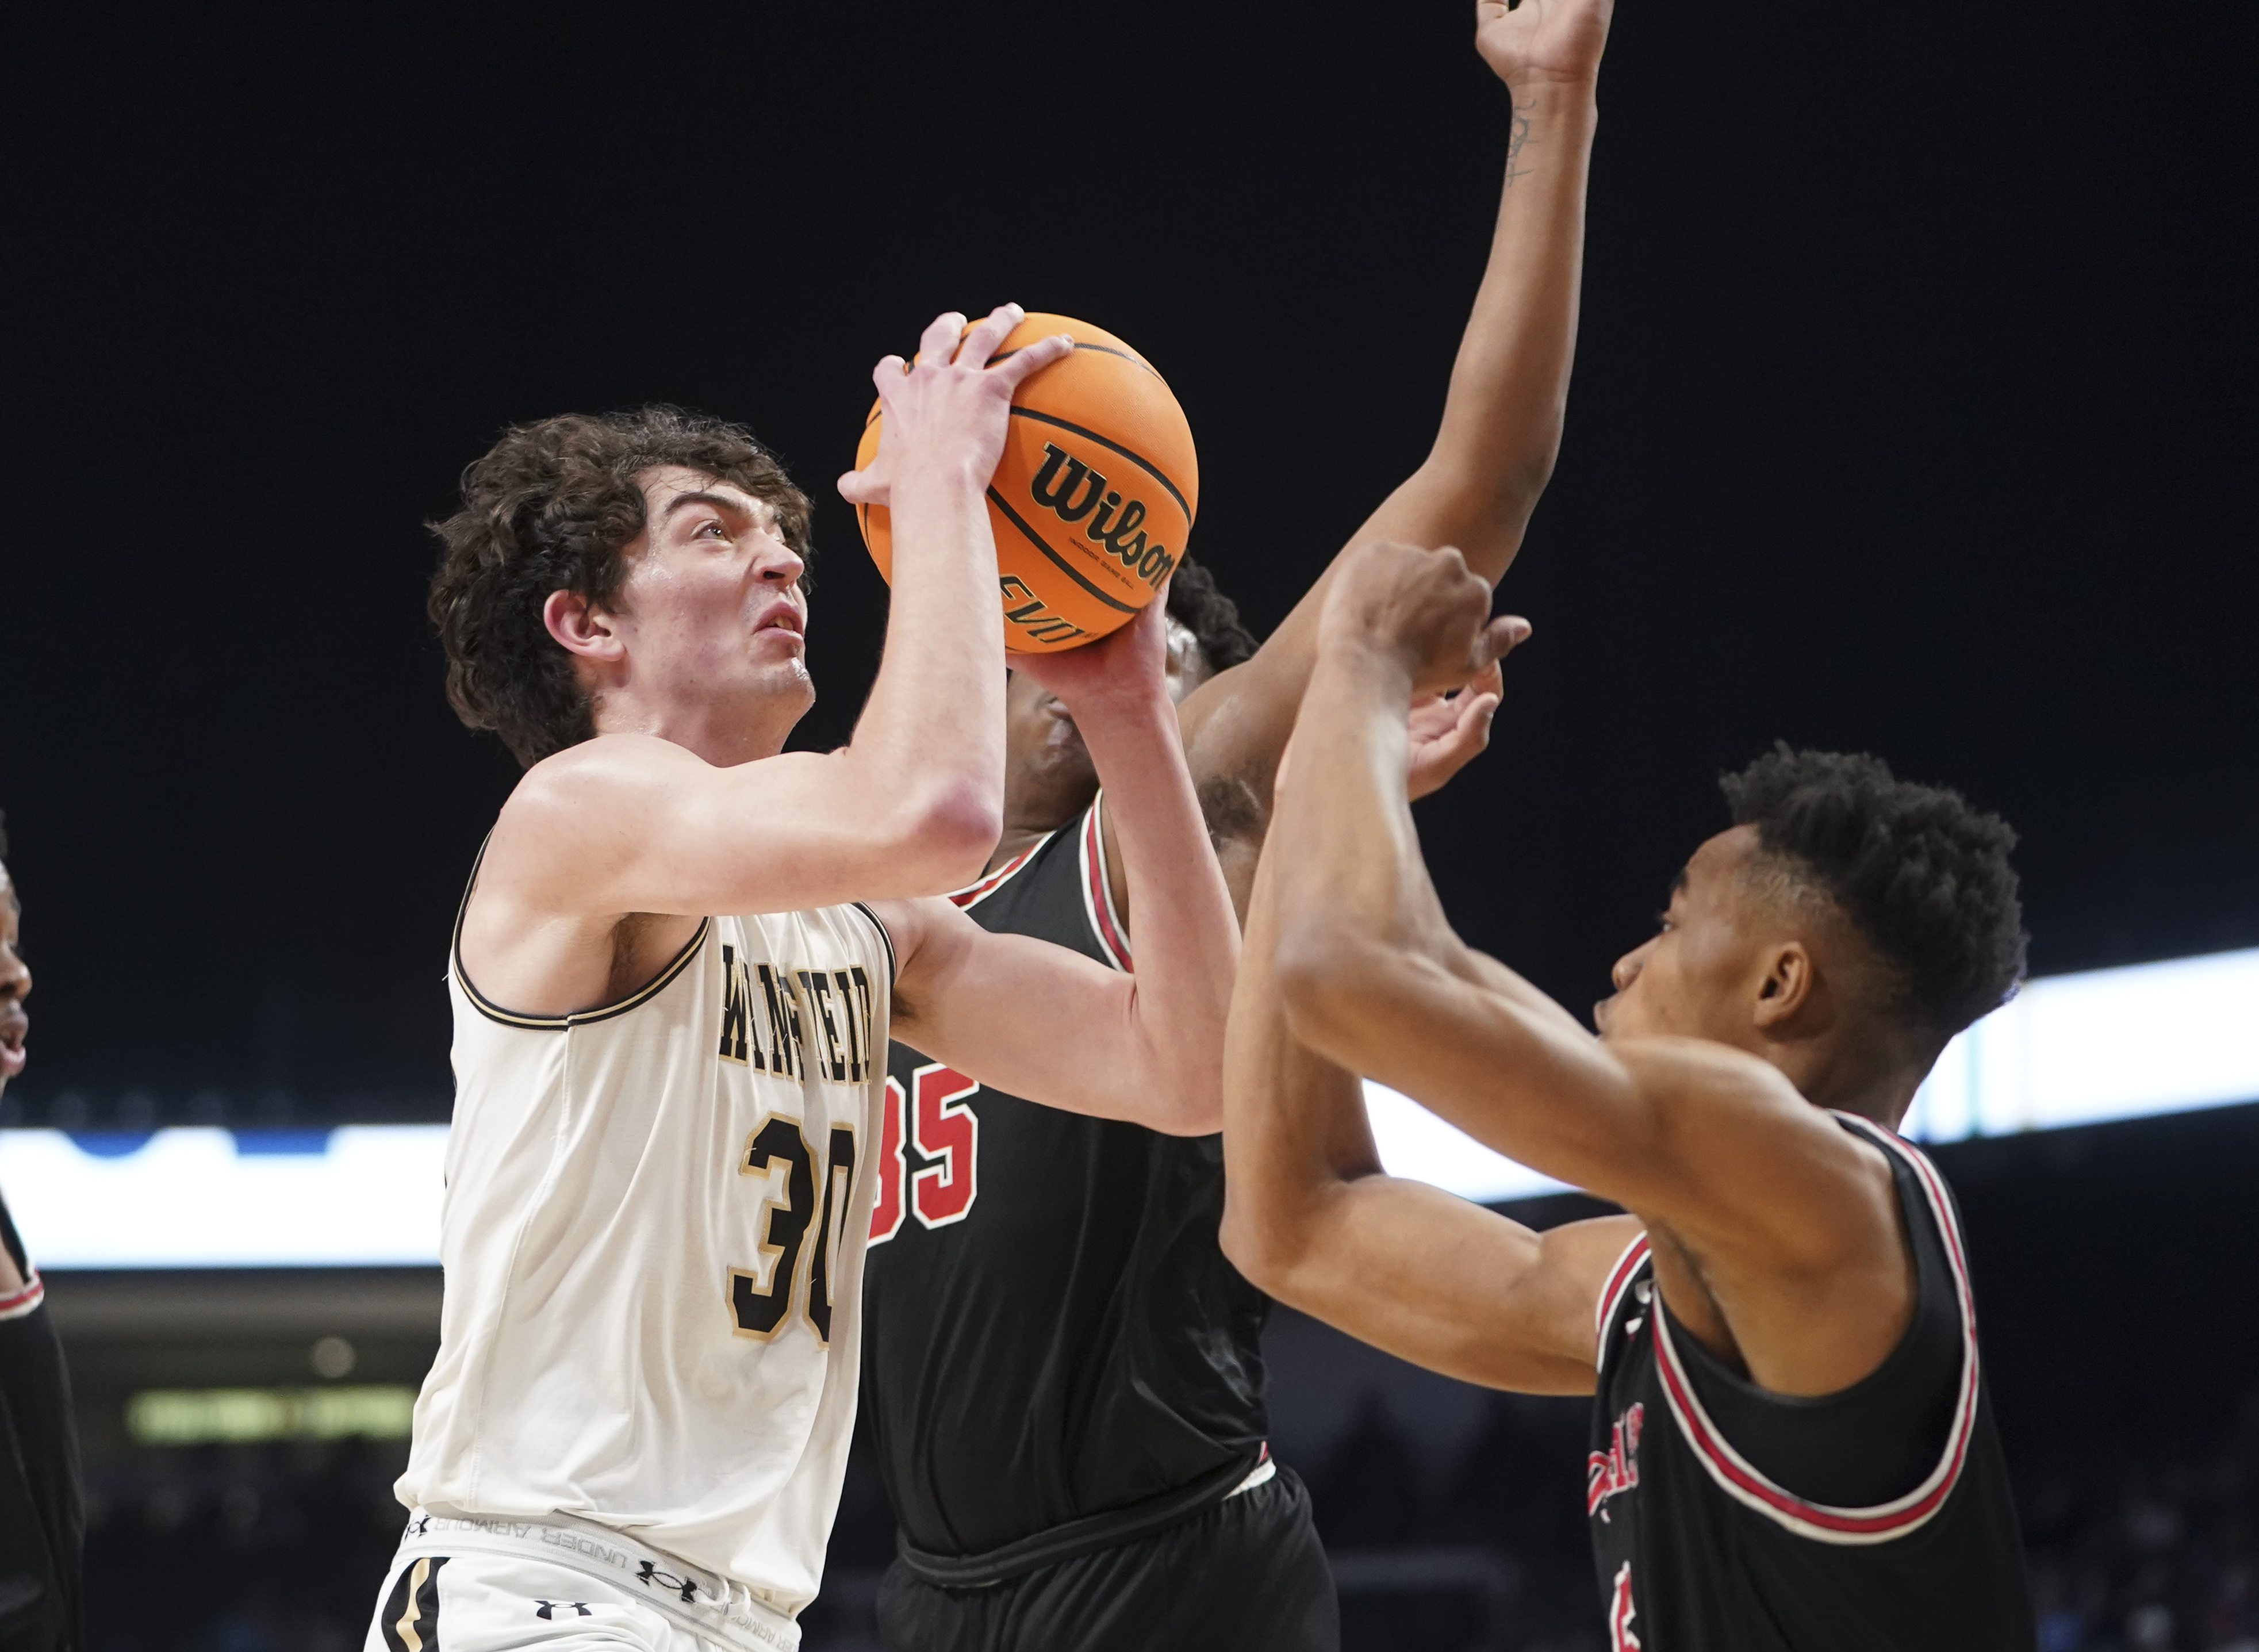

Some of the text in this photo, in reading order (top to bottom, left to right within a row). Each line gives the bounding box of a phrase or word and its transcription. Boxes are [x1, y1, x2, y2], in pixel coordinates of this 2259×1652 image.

[1030, 440, 1175, 592] Wilson
[1068, 536, 1100, 562] INDOOR
[724, 1110, 859, 1351] 30
[433, 1517, 628, 1569] UNDER ARMOUR
